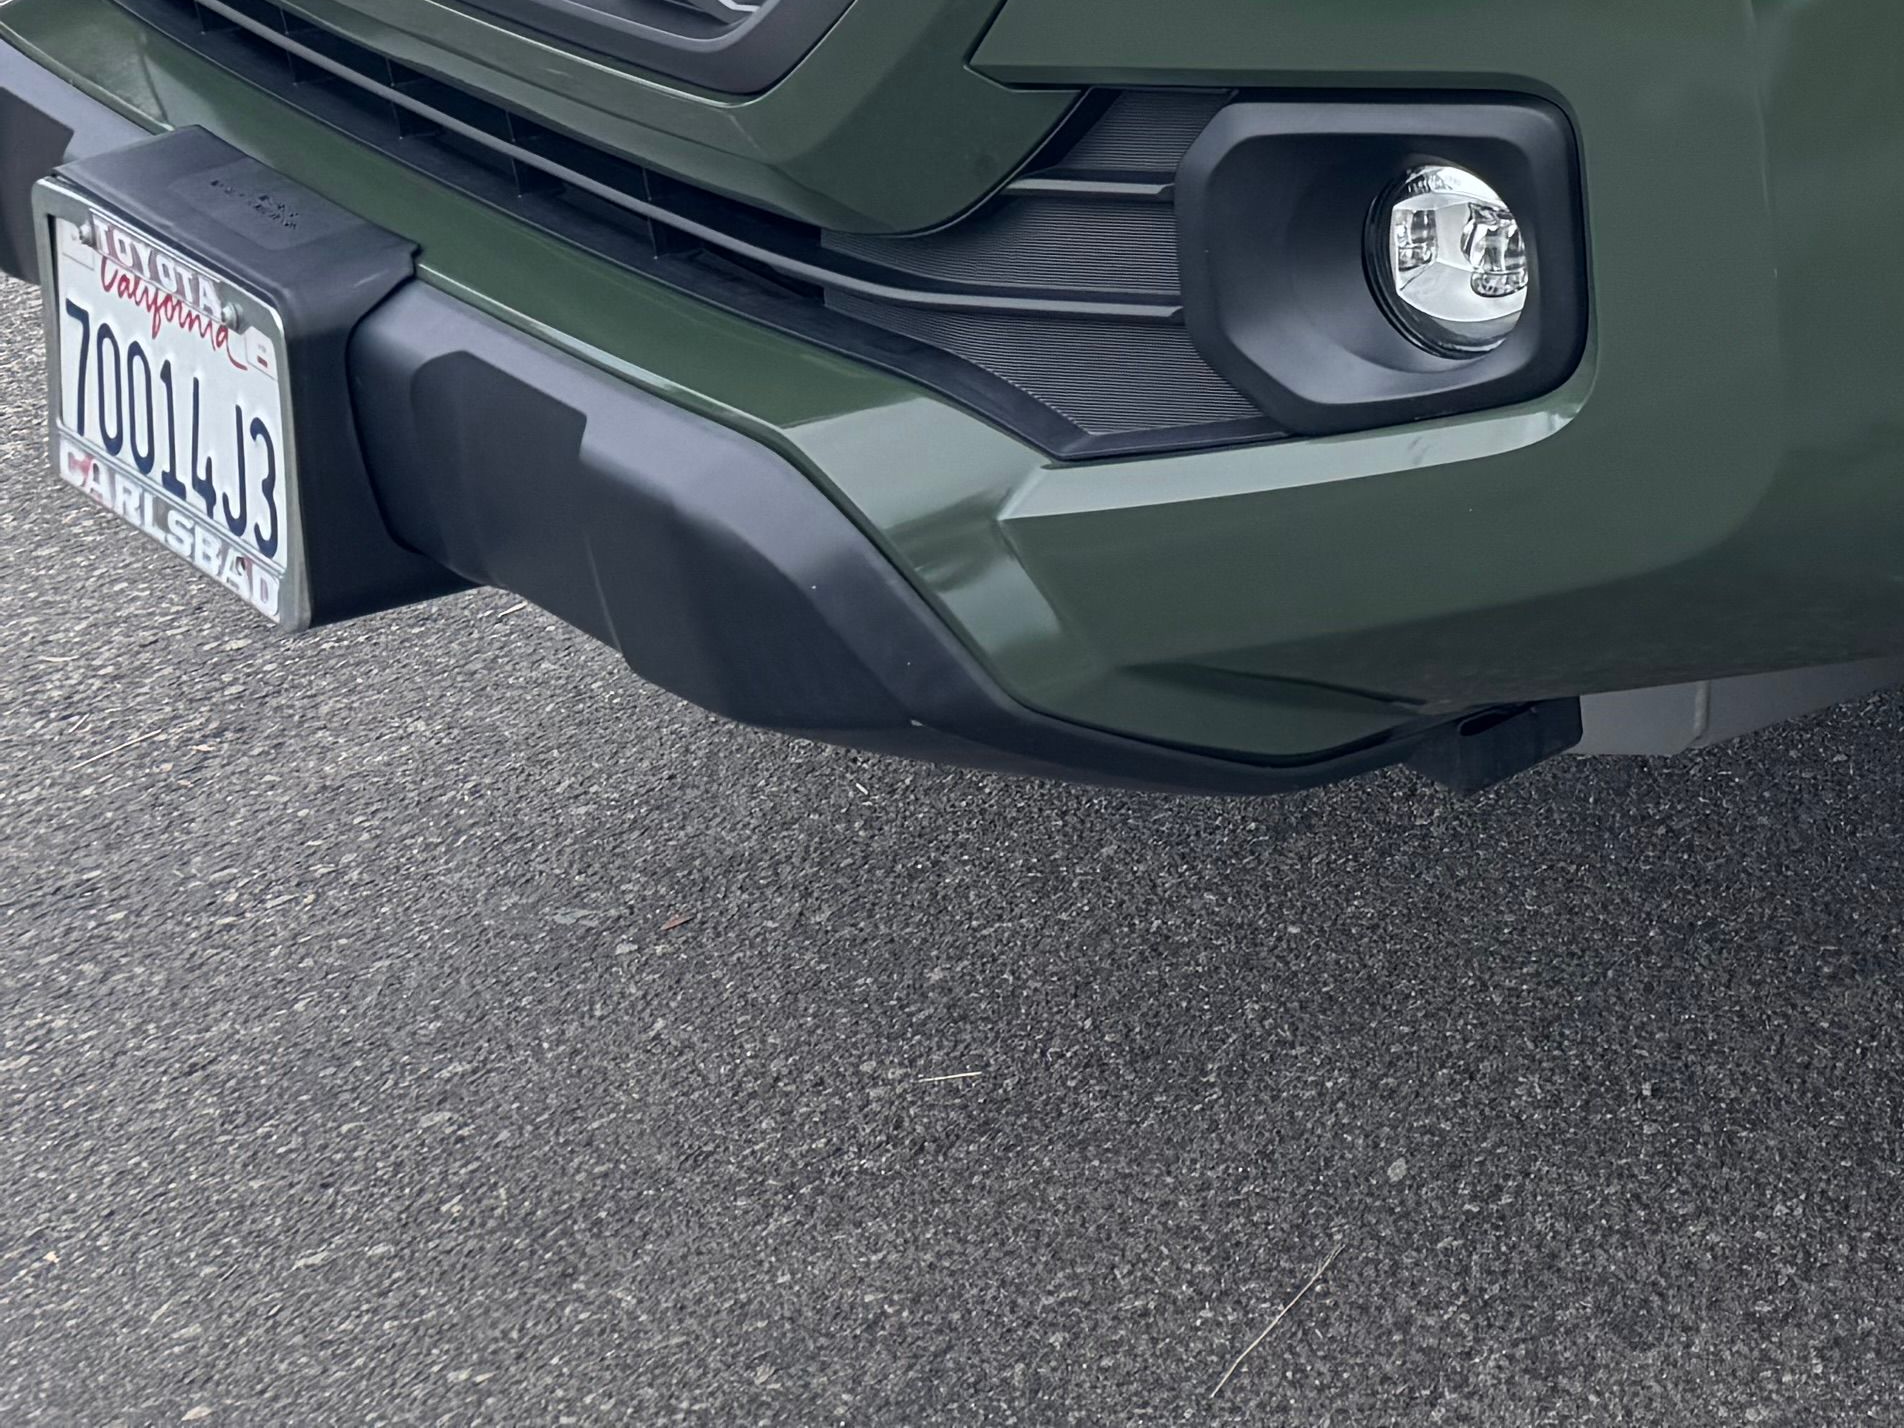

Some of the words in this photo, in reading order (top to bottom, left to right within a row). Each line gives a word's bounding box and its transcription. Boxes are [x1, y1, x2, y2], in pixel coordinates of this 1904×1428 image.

[90, 213, 224, 324] TOYOTA
[100, 256, 249, 372] California
[65, 298, 279, 559] 70014J3
[65, 447, 281, 619] CARLSBAD
